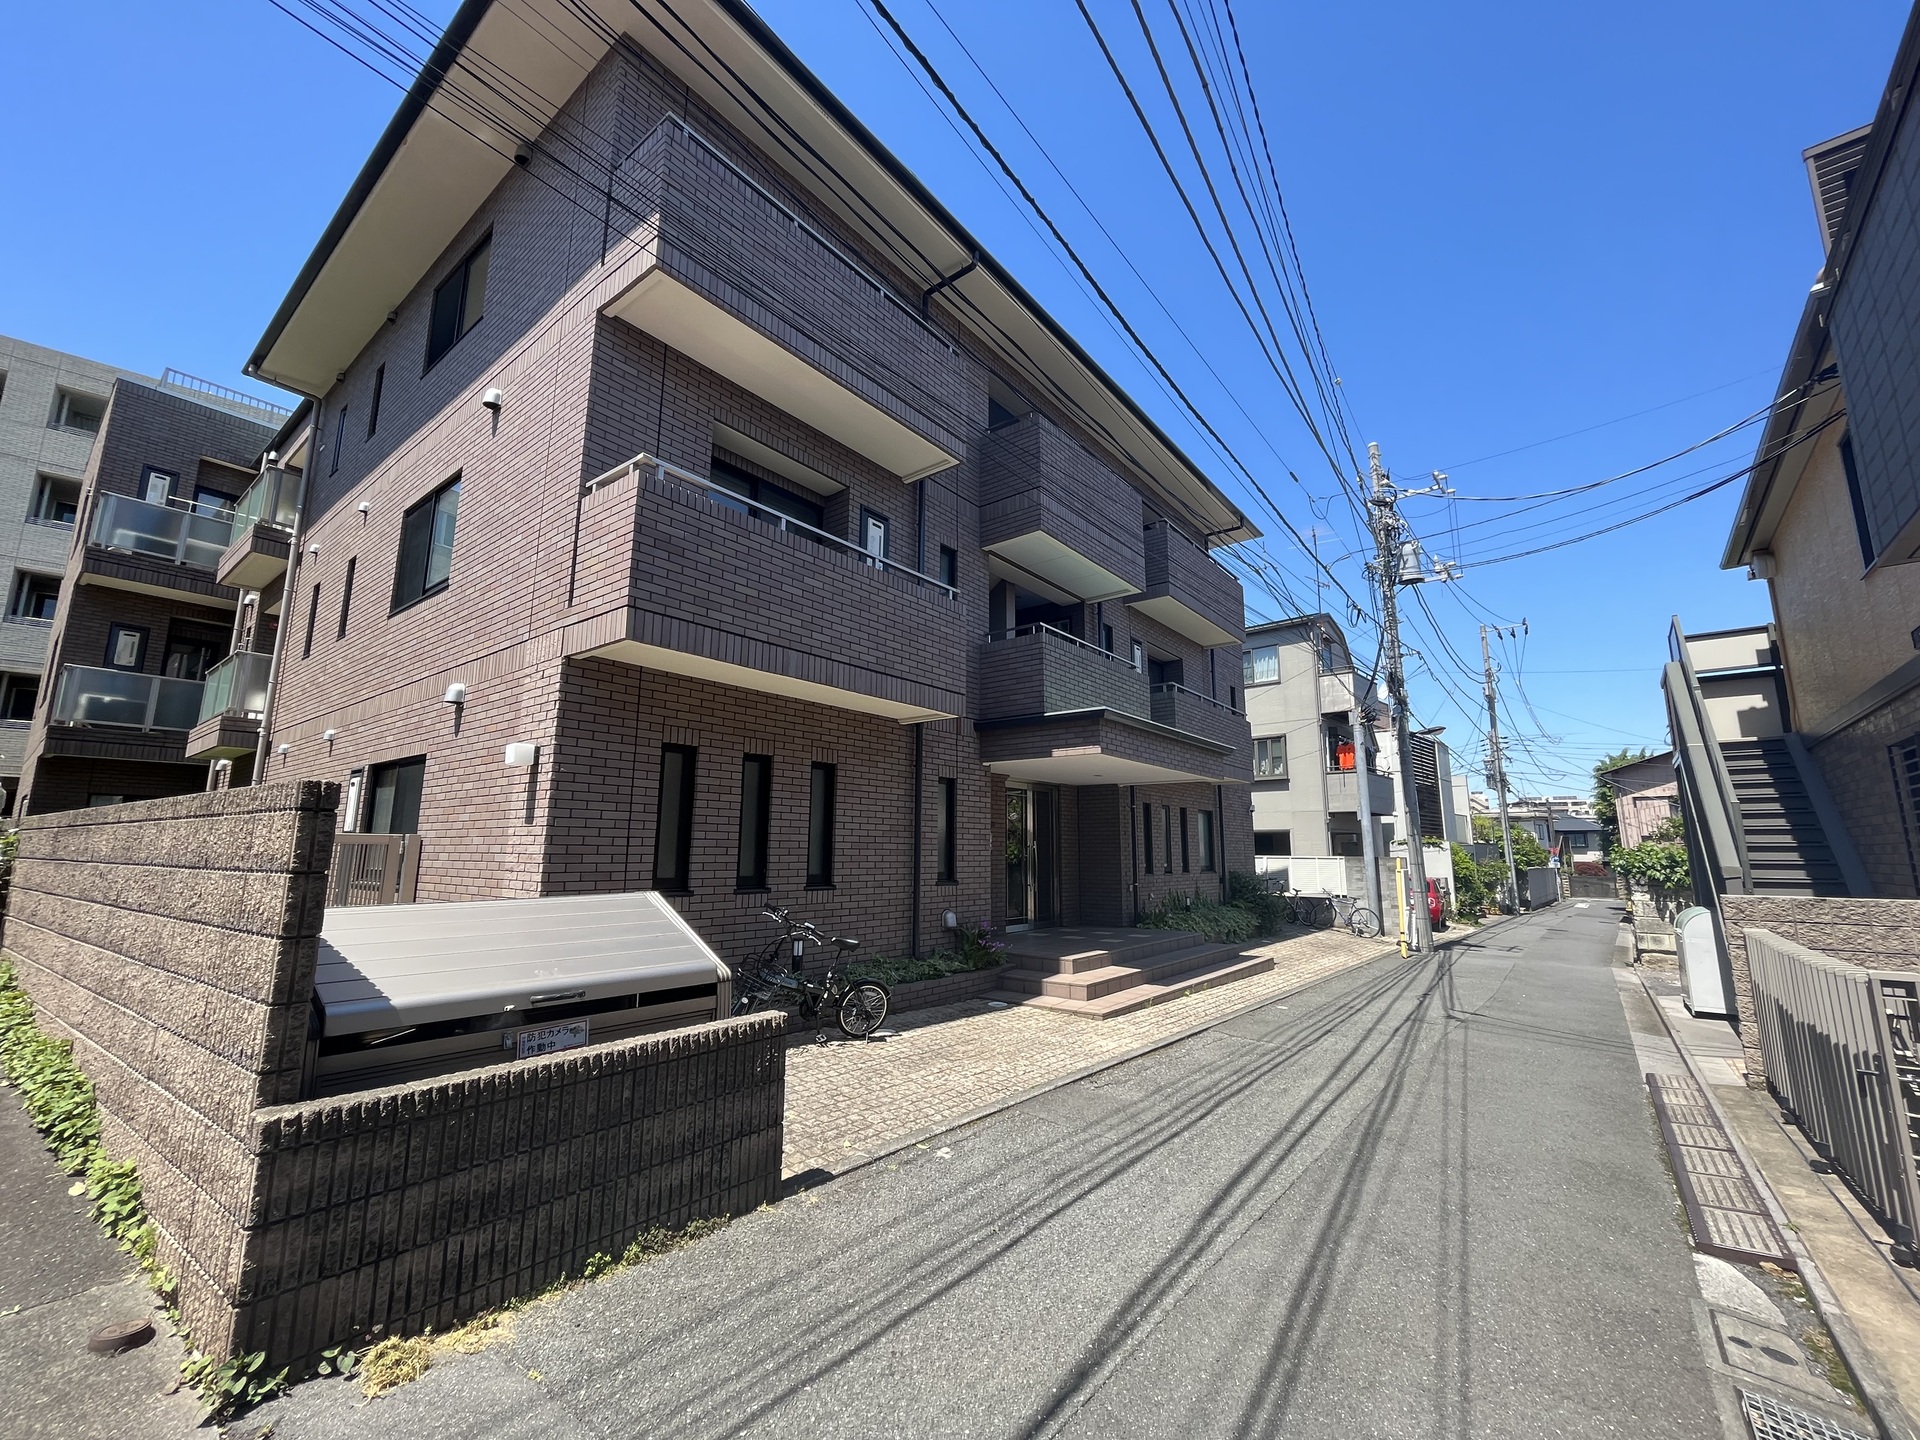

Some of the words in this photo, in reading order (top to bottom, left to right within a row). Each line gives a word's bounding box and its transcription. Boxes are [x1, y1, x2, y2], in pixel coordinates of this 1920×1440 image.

[527, 1026, 569, 1042] 防犯カメラ
[527, 1041, 556, 1055] 作動中
